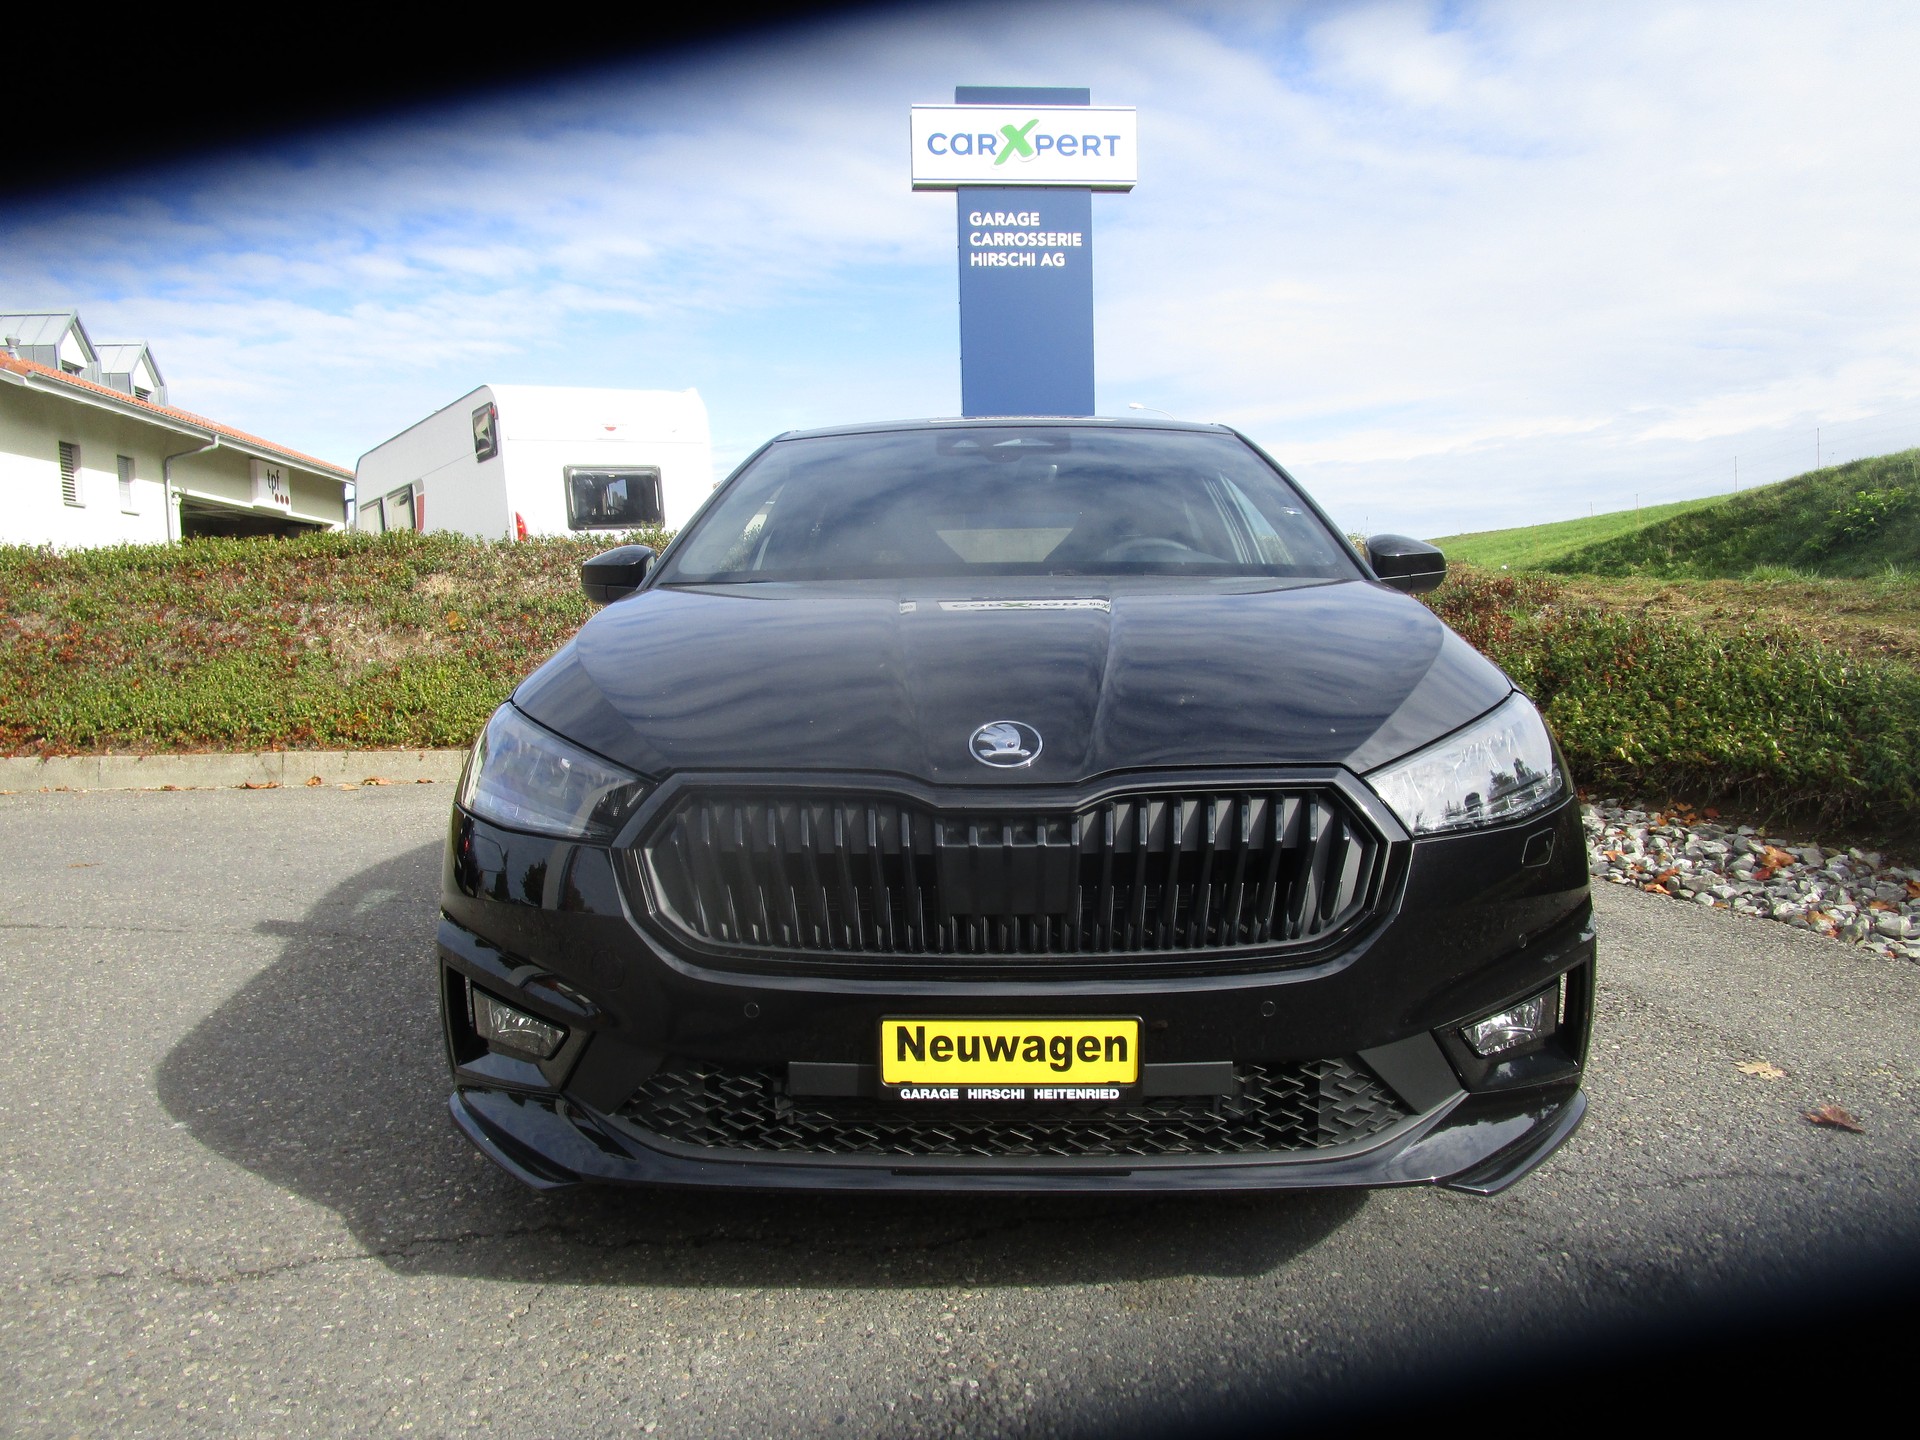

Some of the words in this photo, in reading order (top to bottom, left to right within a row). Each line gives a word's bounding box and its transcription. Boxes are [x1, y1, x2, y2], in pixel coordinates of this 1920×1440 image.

[969, 212, 1040, 226] GARAGE
[969, 232, 1082, 247] CARROSSERIE
[970, 252, 1035, 267] HIRSCHI
[1040, 252, 1065, 267] AG
[267, 469, 280, 495] tpf
[896, 1026, 1128, 1072] Neuwagen
[900, 1088, 959, 1100] GARAGE
[967, 1088, 1025, 1100] HIRSCHI
[1033, 1088, 1120, 1100] HEITENRIED
